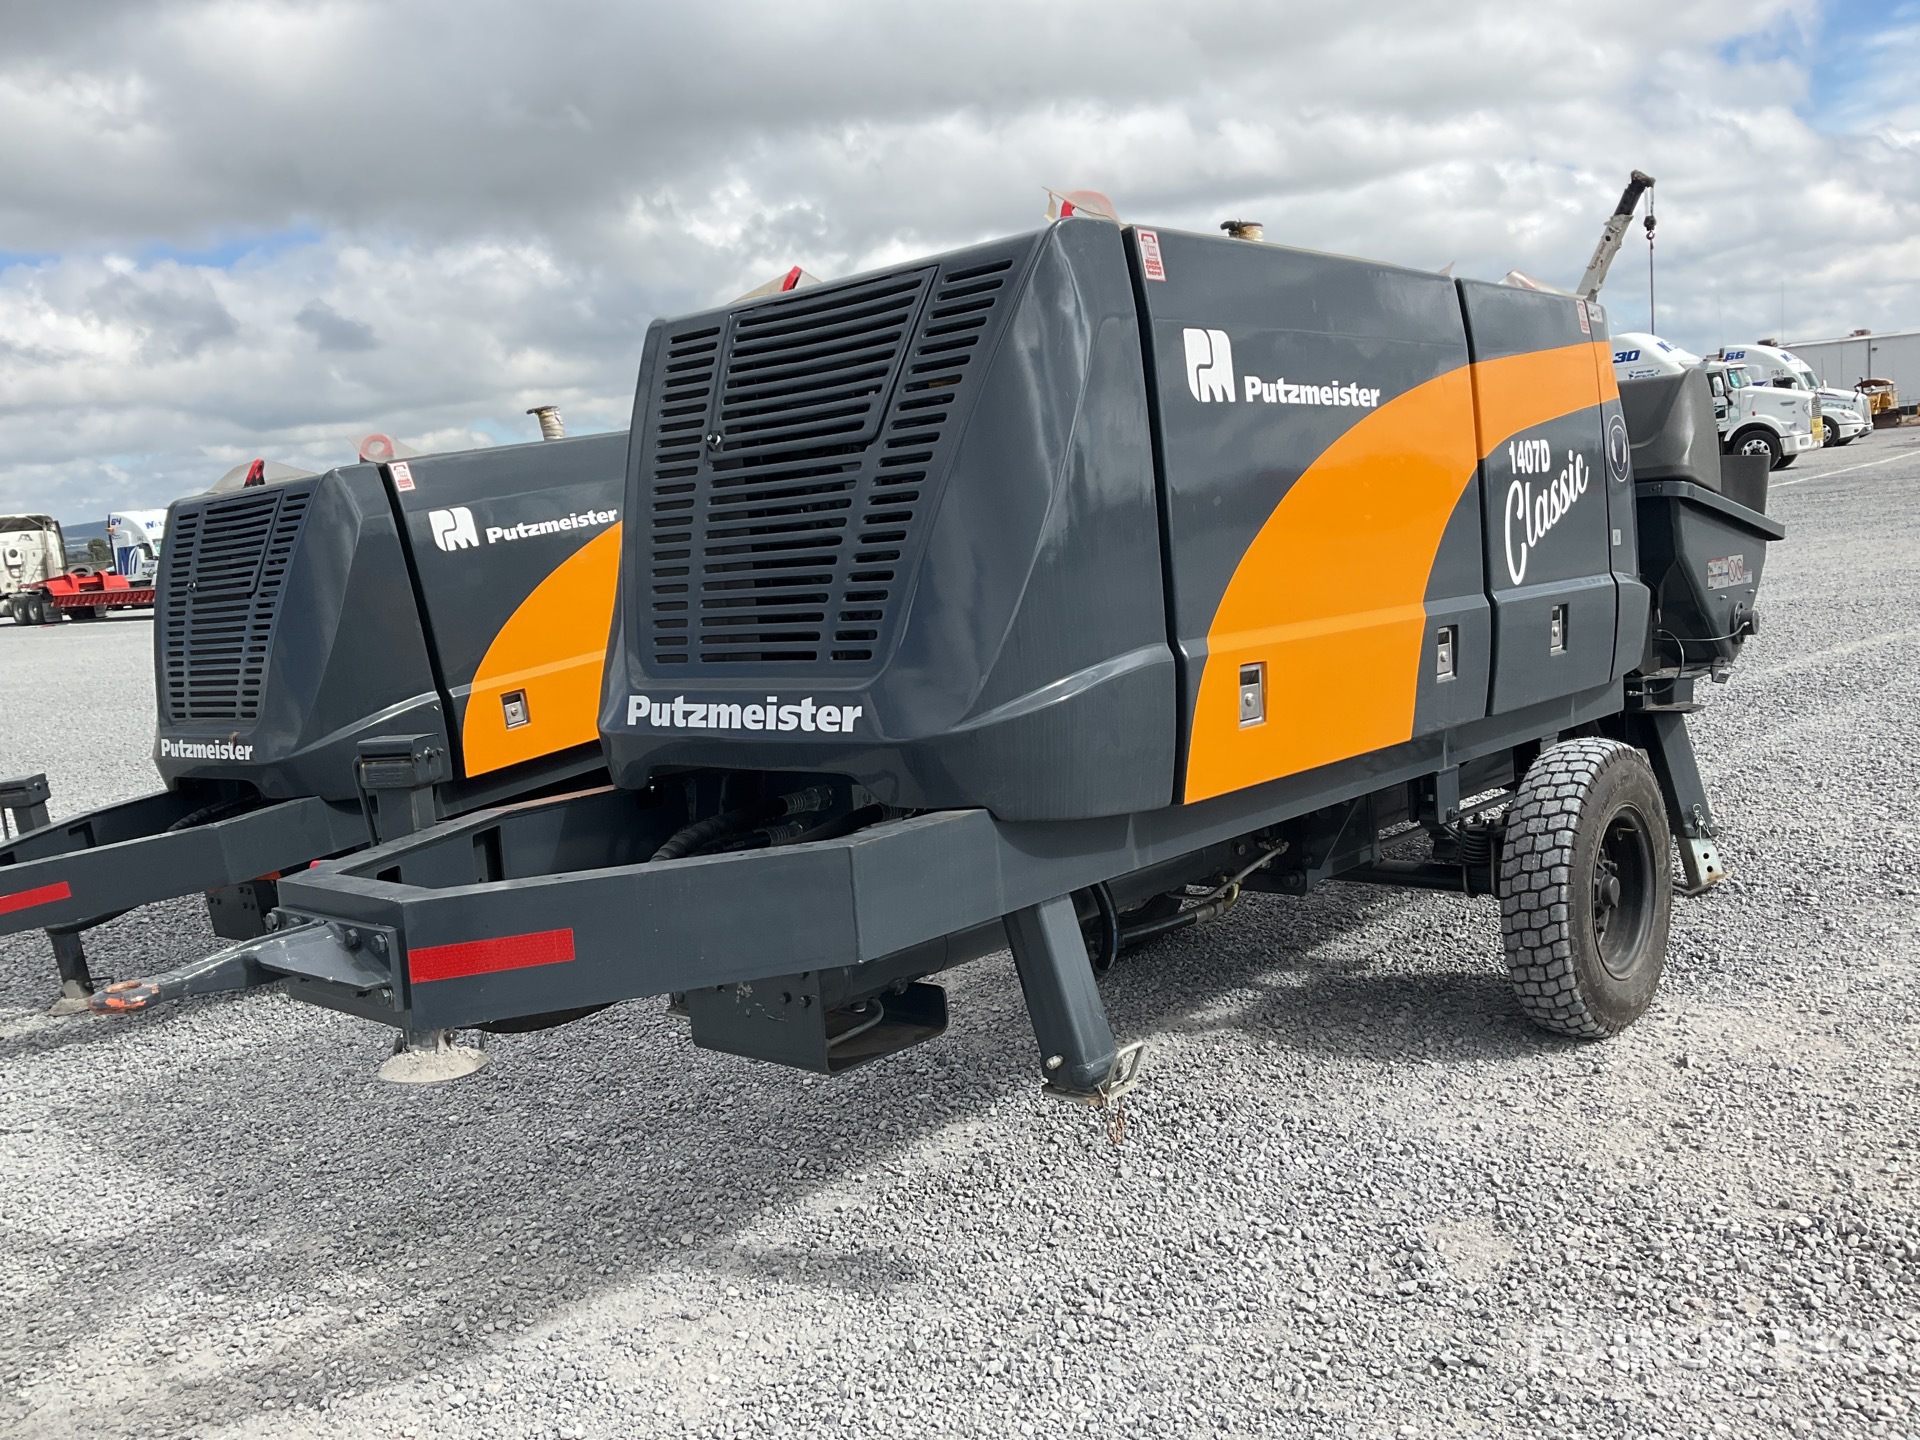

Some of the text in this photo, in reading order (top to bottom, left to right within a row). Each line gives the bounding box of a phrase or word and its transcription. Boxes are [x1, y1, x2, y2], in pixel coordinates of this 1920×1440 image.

[1612, 350, 1641, 364] 30
[1723, 351, 1746, 362] 66
[1244, 375, 1380, 407] Putzmeister
[1508, 439, 1551, 474] 1407D
[485, 509, 617, 544] Putzmeister
[1504, 449, 1589, 585] Classic
[627, 694, 862, 732] Putzmeister
[161, 738, 253, 760] Putzmeister
